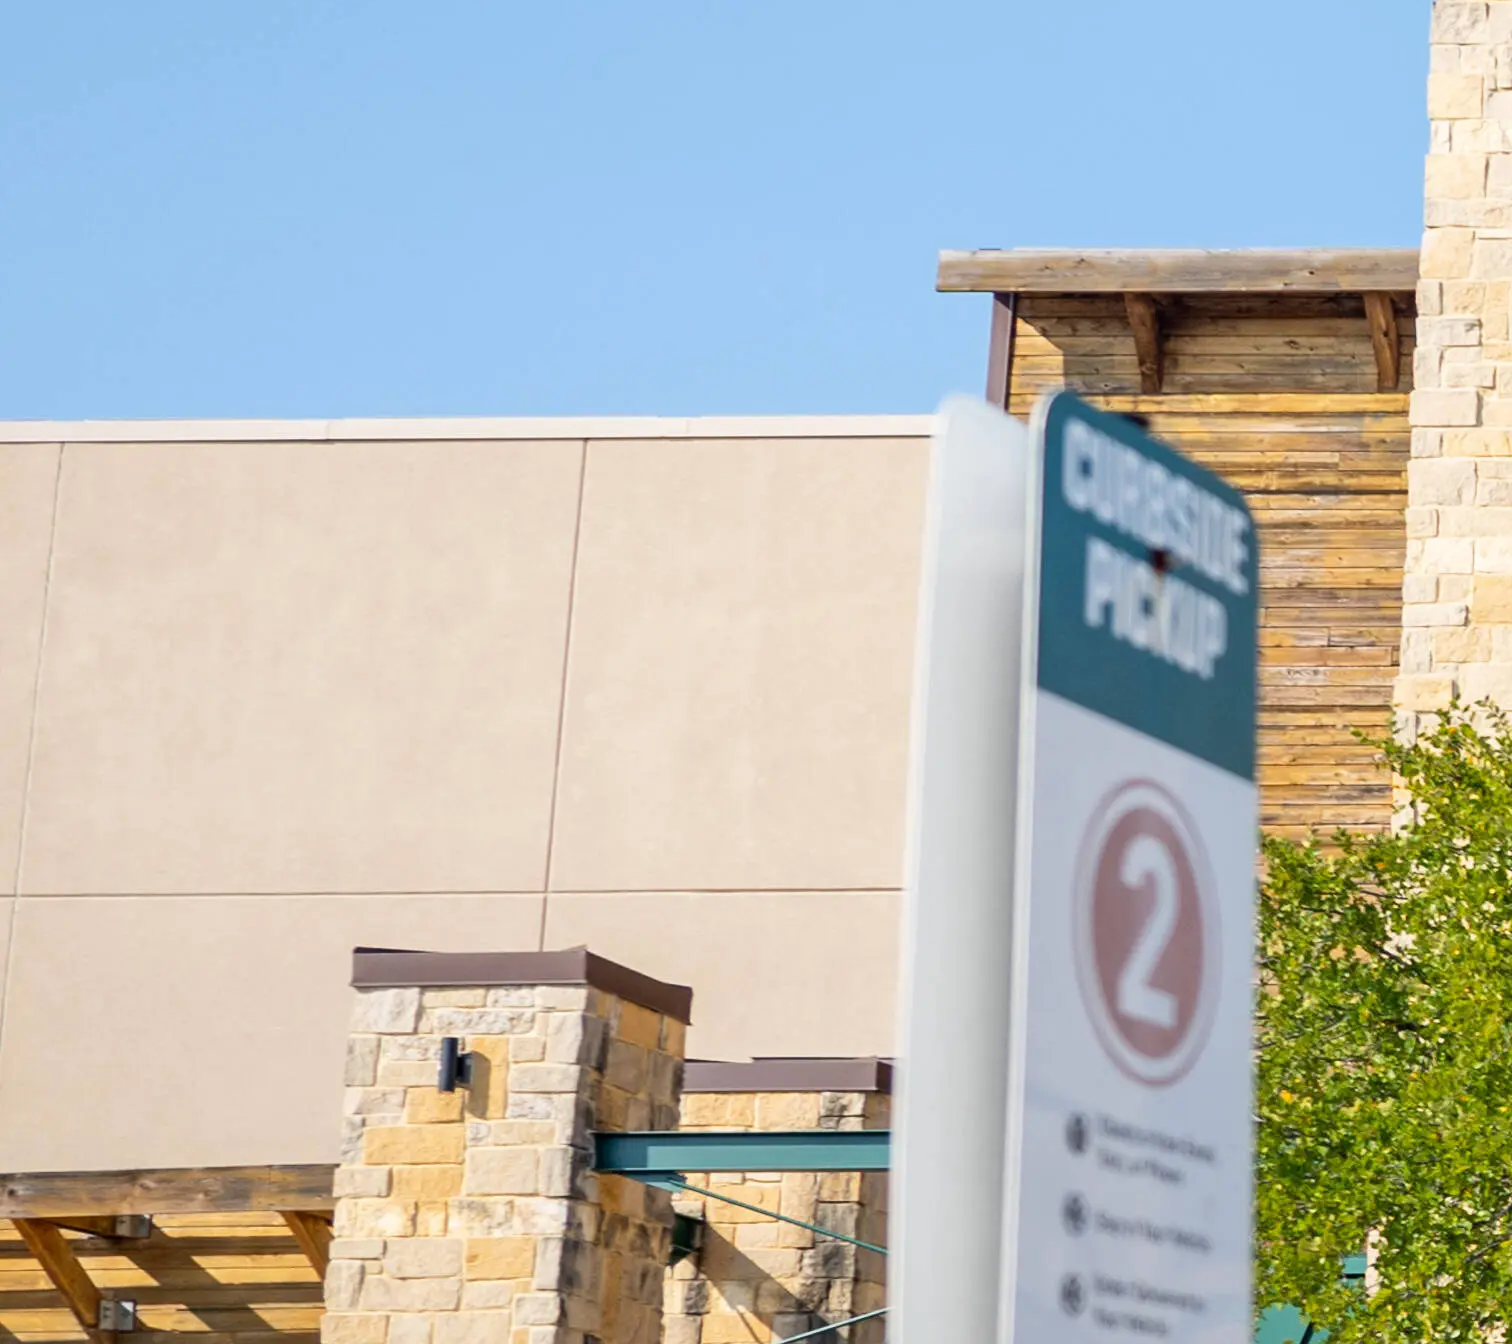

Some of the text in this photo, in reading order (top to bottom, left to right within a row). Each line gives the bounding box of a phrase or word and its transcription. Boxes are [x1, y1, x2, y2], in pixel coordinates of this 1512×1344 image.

[1062, 414, 1250, 597] CURBSIDE
[1084, 534, 1229, 681] PICKUP
[1117, 834, 1180, 1031] 2
